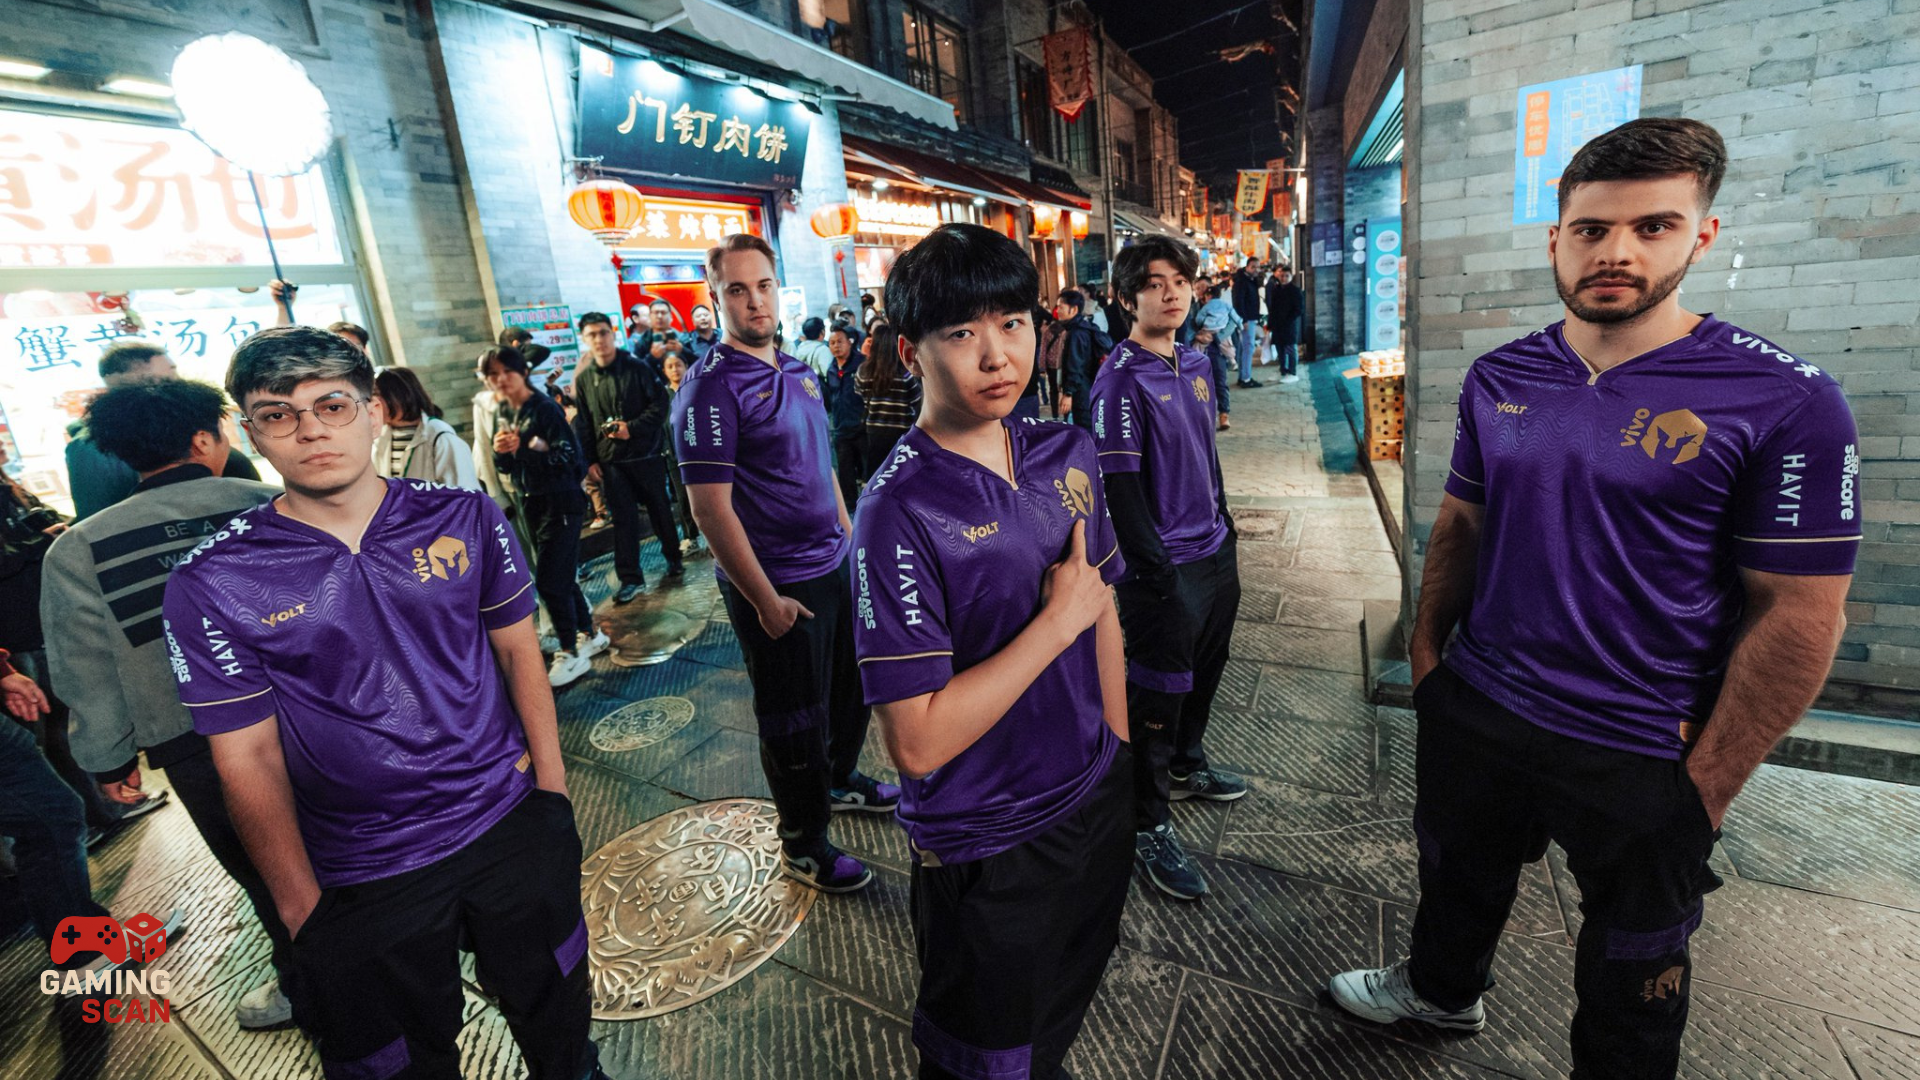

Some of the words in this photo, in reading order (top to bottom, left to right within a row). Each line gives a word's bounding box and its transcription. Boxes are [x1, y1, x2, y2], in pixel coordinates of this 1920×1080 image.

[617, 90, 788, 164] 门钉肉饼
[1732, 333, 1794, 363] vivo
[710, 405, 722, 446] HAVIT
[1121, 397, 1131, 439] HAVIT
[1496, 402, 1527, 415] VOLT
[1620, 408, 1650, 447] vivo
[872, 454, 907, 491] vivo
[1775, 453, 1806, 526] HAVIT
[1840, 443, 1855, 521] savicore
[1053, 479, 1078, 518] vivo
[164, 522, 190, 538] BE
[203, 520, 216, 533] A
[495, 523, 517, 574] HAVIT
[962, 521, 999, 544] VOLT
[412, 547, 432, 583] vivo
[857, 547, 876, 630] savicore
[896, 544, 923, 626] HAVIT
[260, 603, 306, 628] VOLT
[202, 617, 243, 677] HAVIT
[1640, 978, 1654, 1002] vivo
